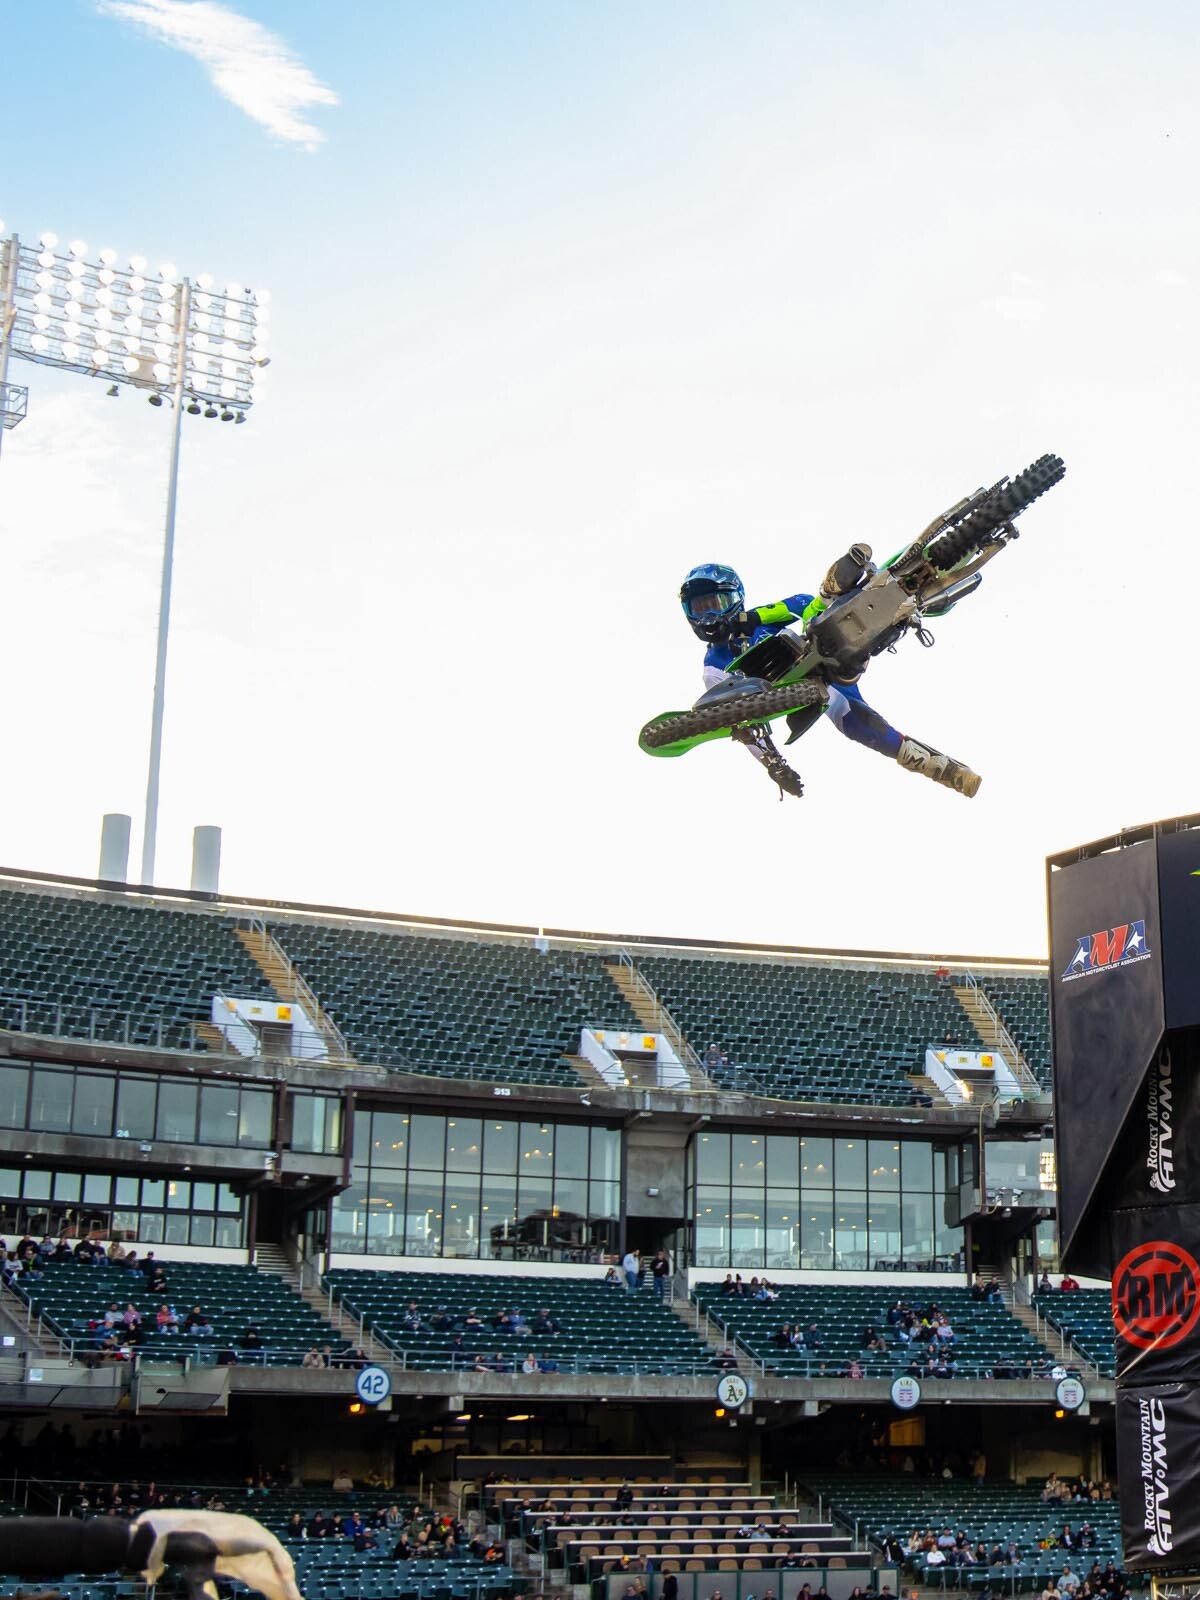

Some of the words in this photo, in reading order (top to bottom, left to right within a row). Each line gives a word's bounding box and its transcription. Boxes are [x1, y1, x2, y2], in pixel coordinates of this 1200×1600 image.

[1061, 919, 1152, 977] AMA
[1146, 1125, 1159, 1169] ROCKY
[1127, 1271, 1186, 1319] RM
[361, 1375, 384, 1394] 42
[1139, 1398, 1153, 1480] MOUNTAIN
[1144, 1481, 1156, 1532] ROCKY
